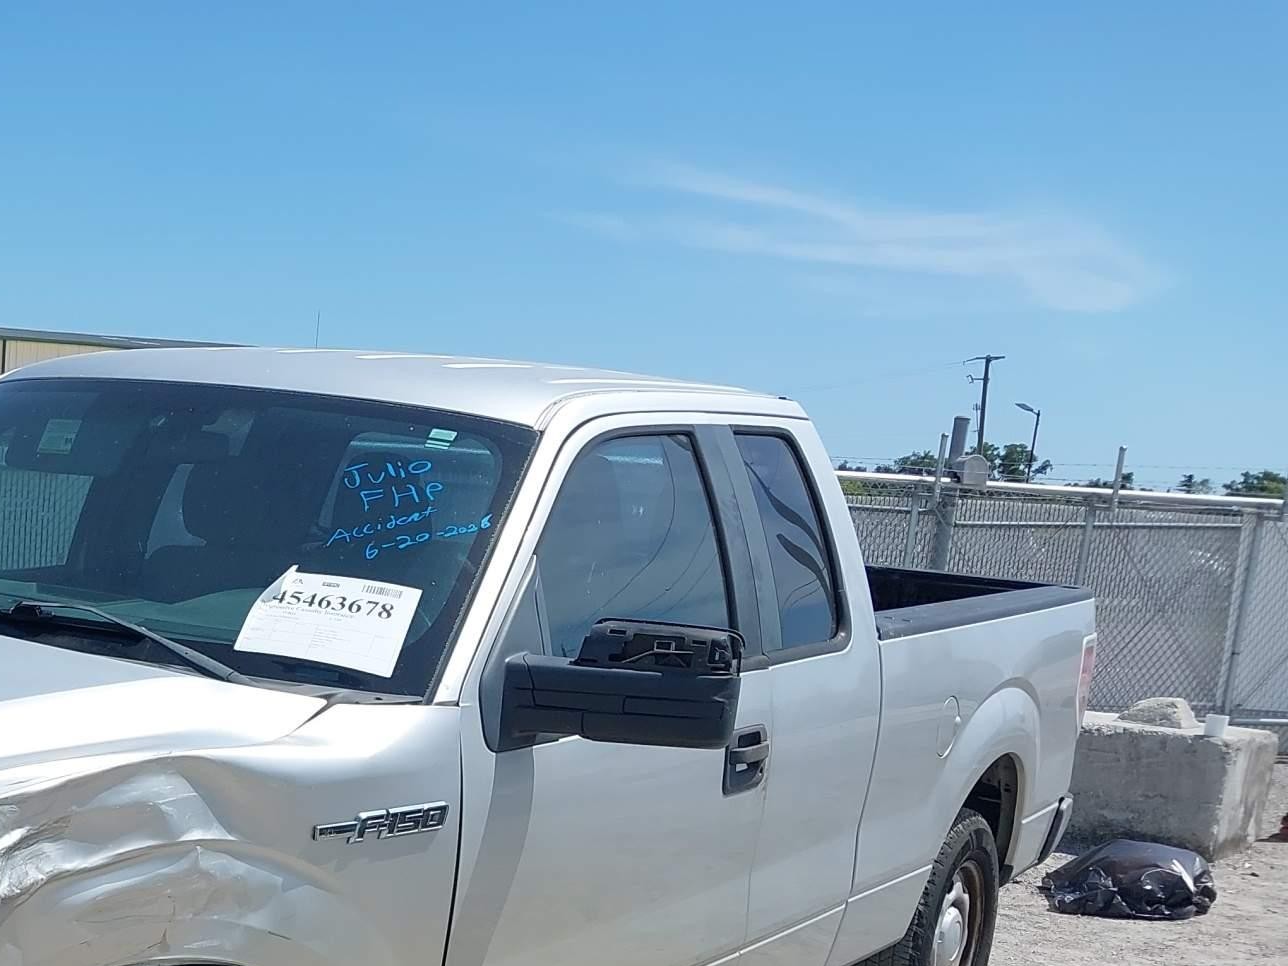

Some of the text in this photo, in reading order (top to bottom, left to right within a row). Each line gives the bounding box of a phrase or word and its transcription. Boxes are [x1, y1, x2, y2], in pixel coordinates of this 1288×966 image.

[344, 460, 432, 488] Julio
[360, 481, 443, 511] FHP
[272, 589, 394, 620] 45463678
